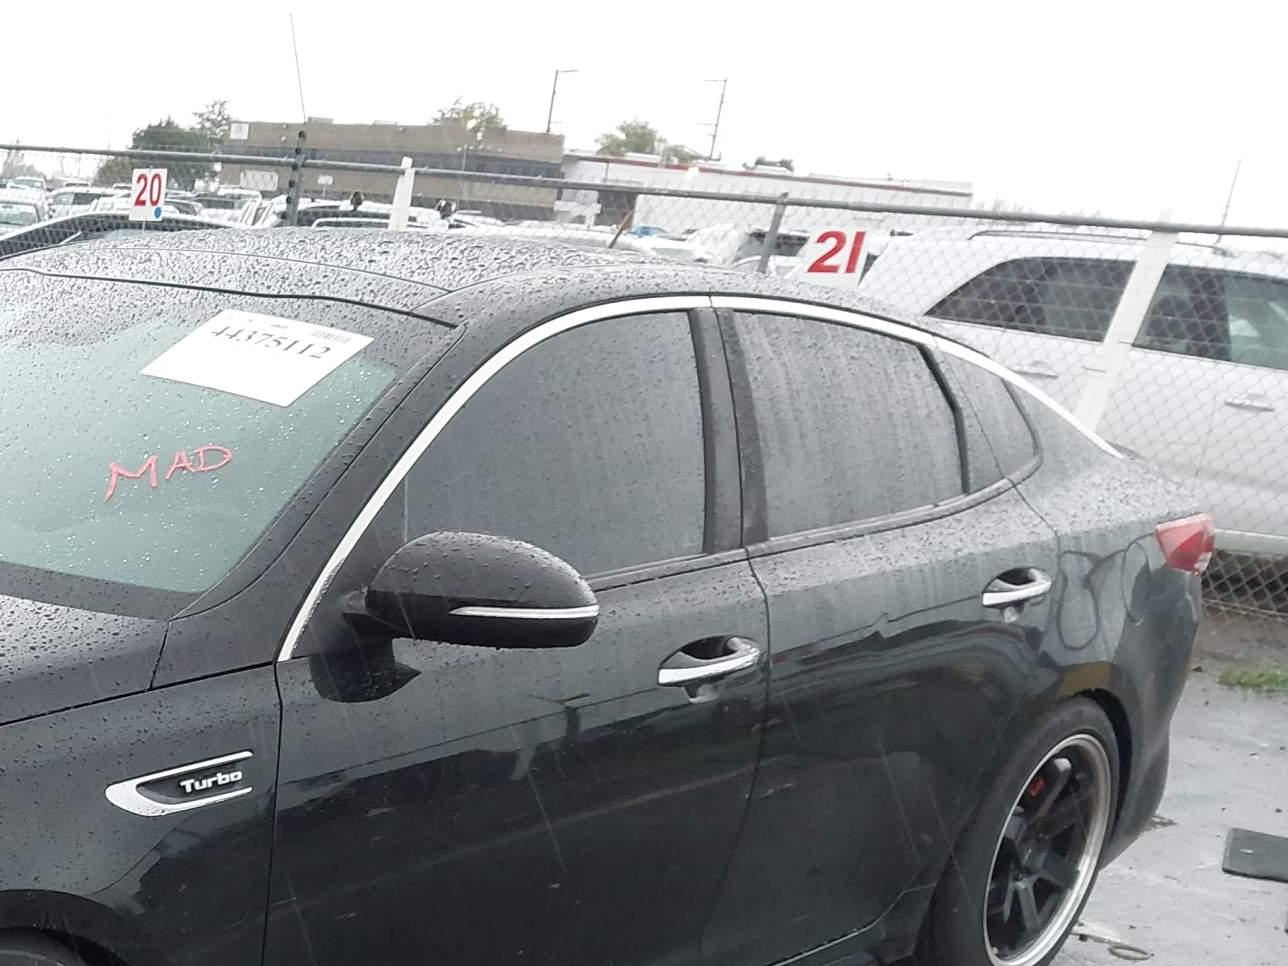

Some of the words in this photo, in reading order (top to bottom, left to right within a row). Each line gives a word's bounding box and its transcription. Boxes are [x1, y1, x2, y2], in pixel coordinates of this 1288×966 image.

[134, 173, 162, 207] 20
[807, 230, 867, 274] 21
[211, 326, 332, 359] 44375112
[104, 444, 233, 502] MAD
[179, 770, 243, 793] Turbo
